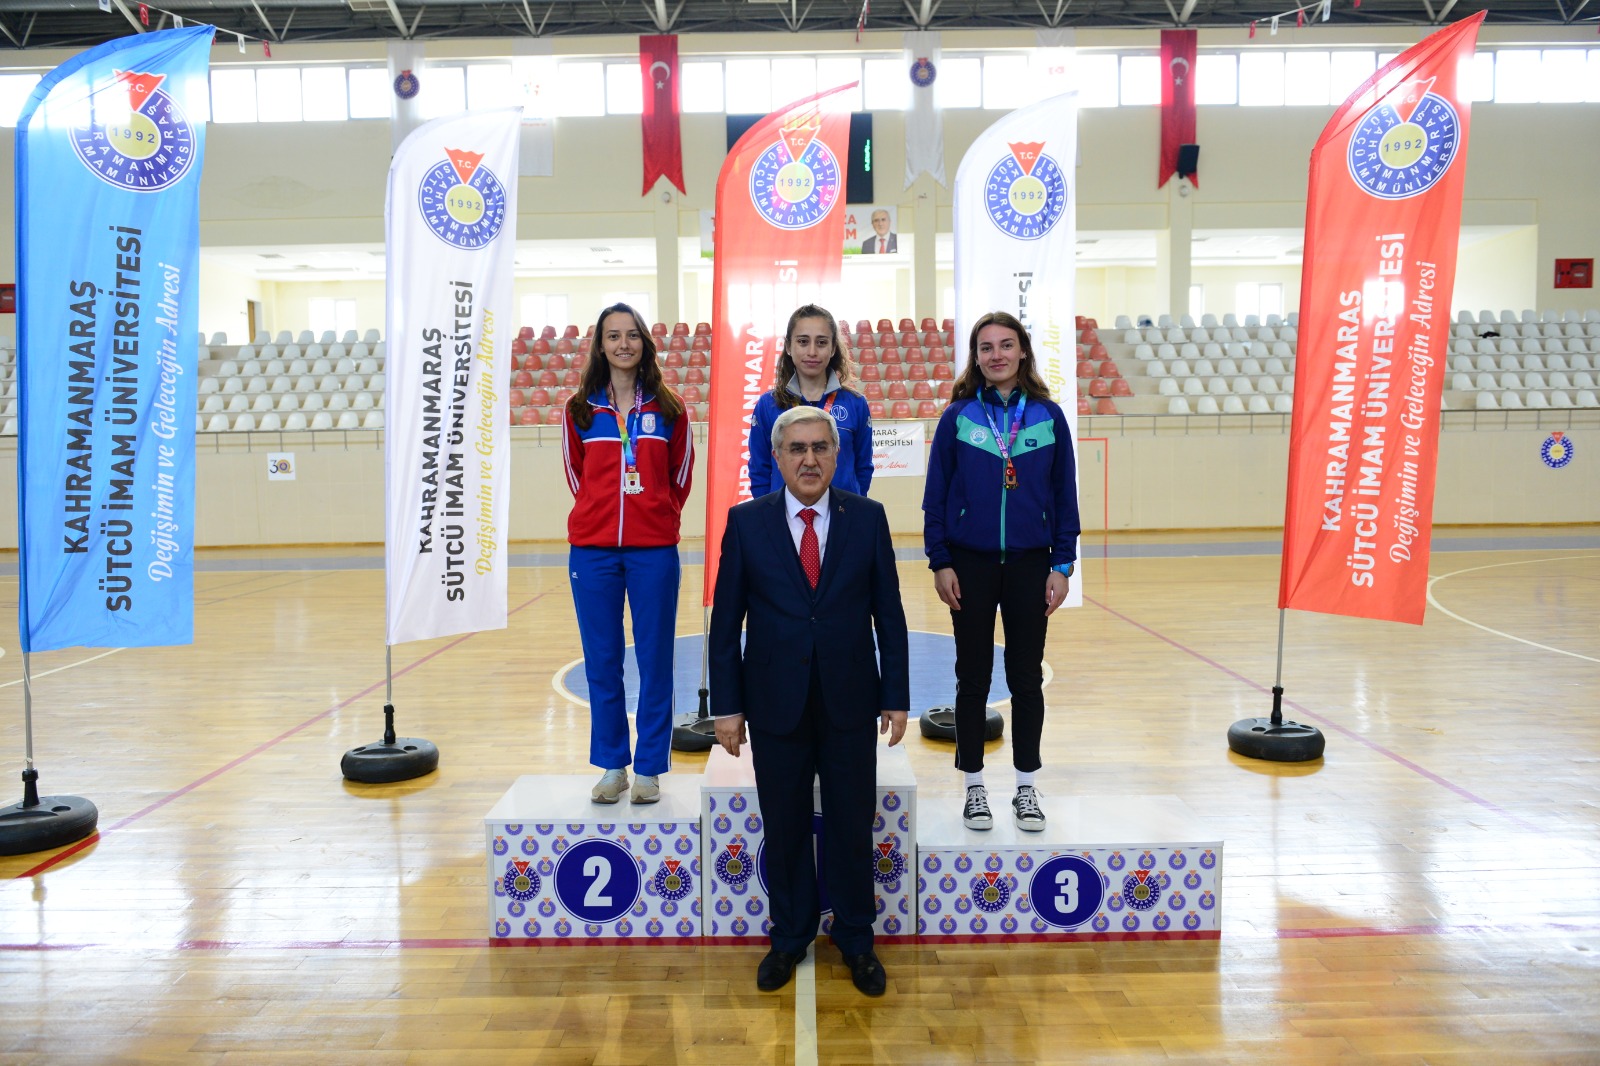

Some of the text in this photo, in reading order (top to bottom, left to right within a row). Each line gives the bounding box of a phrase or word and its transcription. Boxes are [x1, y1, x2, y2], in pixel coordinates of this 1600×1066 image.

[112, 127, 155, 144] 1992
[790, 137, 807, 147] T.C.
[1019, 151, 1036, 160] T.C.
[1384, 138, 1422, 153] 1992
[456, 159, 475, 170] T.C.
[780, 178, 810, 187] 1992
[449, 198, 481, 211] 1992
[1013, 191, 1043, 201] 1992
[63, 279, 104, 554] KAHRAMANMARAŞ
[98, 225, 142, 612] SÜTCÜ İMAM ÜNİVERSİTESİ
[147, 262, 183, 583] Değişimin ve Geleceğin Adresi
[474, 378, 498, 456] Geleceğin
[1346, 232, 1405, 589] SÜTCÜ İMAM ÜNİVERESİ
[1388, 260, 1437, 564] Değişimin ve Geleceğin Adresi
[418, 326, 448, 555] KAHRAMANMARAŞ
[440, 280, 473, 602] SÜTCÜ İMAM ÜNİVERSİTESİ
[479, 459, 493, 481] ve
[474, 484, 497, 577] Değişimin
[582, 855, 613, 907] 2
[1053, 869, 1080, 914] 3
